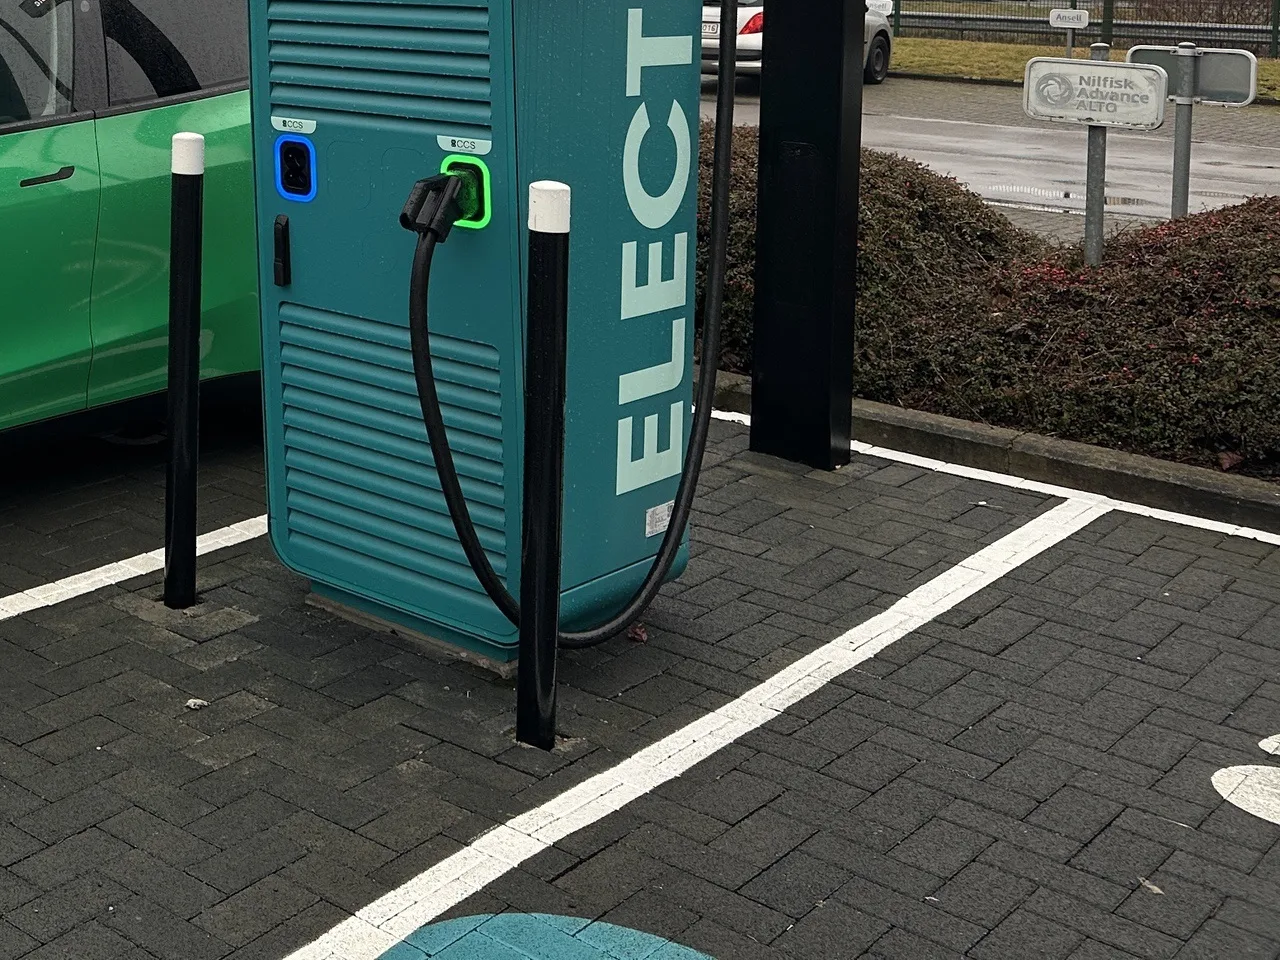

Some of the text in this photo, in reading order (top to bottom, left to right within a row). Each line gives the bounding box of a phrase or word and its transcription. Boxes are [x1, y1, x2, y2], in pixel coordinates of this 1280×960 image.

[1055, 12, 1082, 21] Ansell
[1078, 75, 1134, 90] Nilfisk
[1076, 87, 1150, 104] Advance
[1075, 100, 1117, 113] ALTO
[287, 120, 304, 129] CCS
[456, 139, 476, 150] CCS
